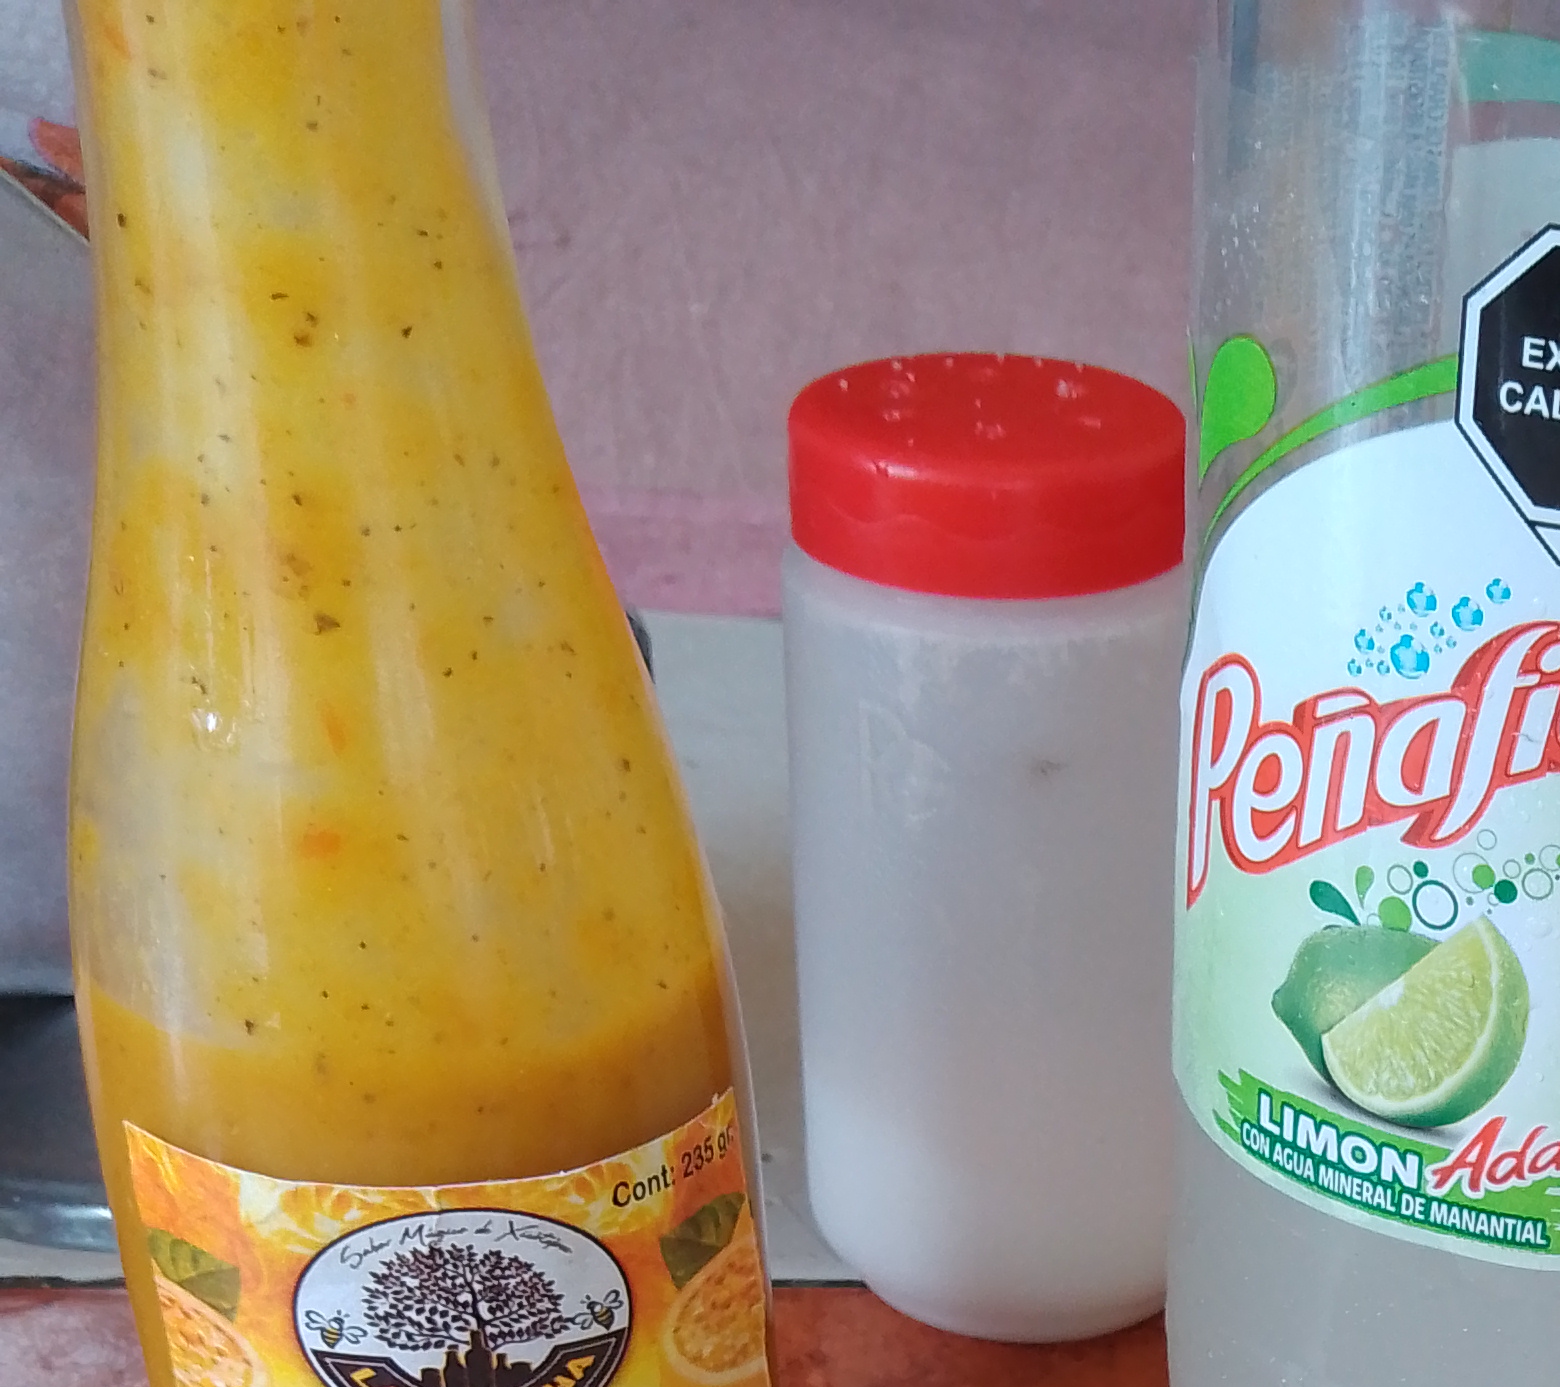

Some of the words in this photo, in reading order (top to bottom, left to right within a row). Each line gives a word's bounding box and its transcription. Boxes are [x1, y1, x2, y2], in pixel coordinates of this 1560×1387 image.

[612, 1165, 676, 1207] Cont:
[681, 1135, 714, 1178] 235
[1242, 1122, 1270, 1160] CON
[1273, 1141, 1314, 1183] AGUA
[1318, 1163, 1397, 1214] MINERAL
[1401, 1193, 1426, 1219] DE
[1430, 1203, 1547, 1246] MANANTIAL
[1258, 1092, 1420, 1189] LIMON
